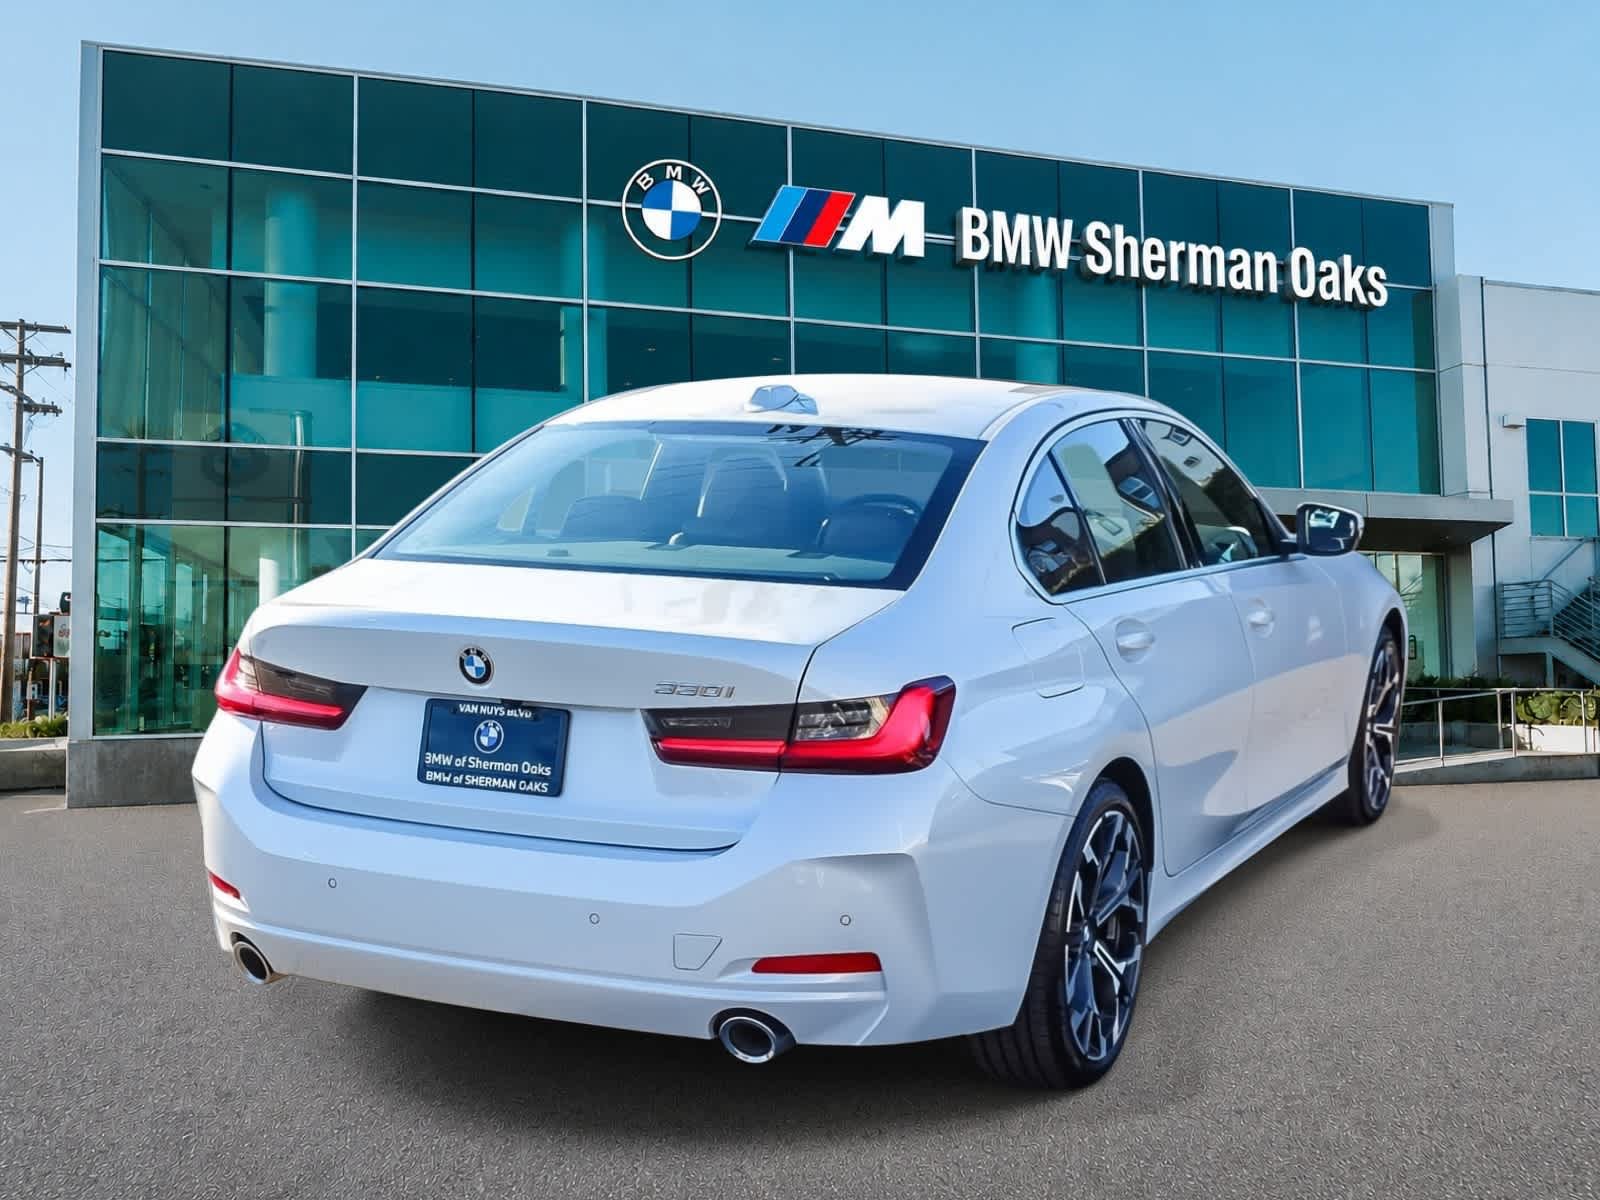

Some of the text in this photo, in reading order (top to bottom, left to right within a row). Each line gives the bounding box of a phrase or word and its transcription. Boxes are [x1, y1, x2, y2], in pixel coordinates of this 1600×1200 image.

[635, 165, 711, 195] BMW
[834, 194, 926, 258] M
[959, 206, 1389, 308] BMW Sherman Oaks
[458, 703, 532, 719] VAN NUYS BLVD
[424, 752, 552, 777] BMW of Sherman Oaks
[425, 770, 549, 794] BMW of SHERMAN OAKS
